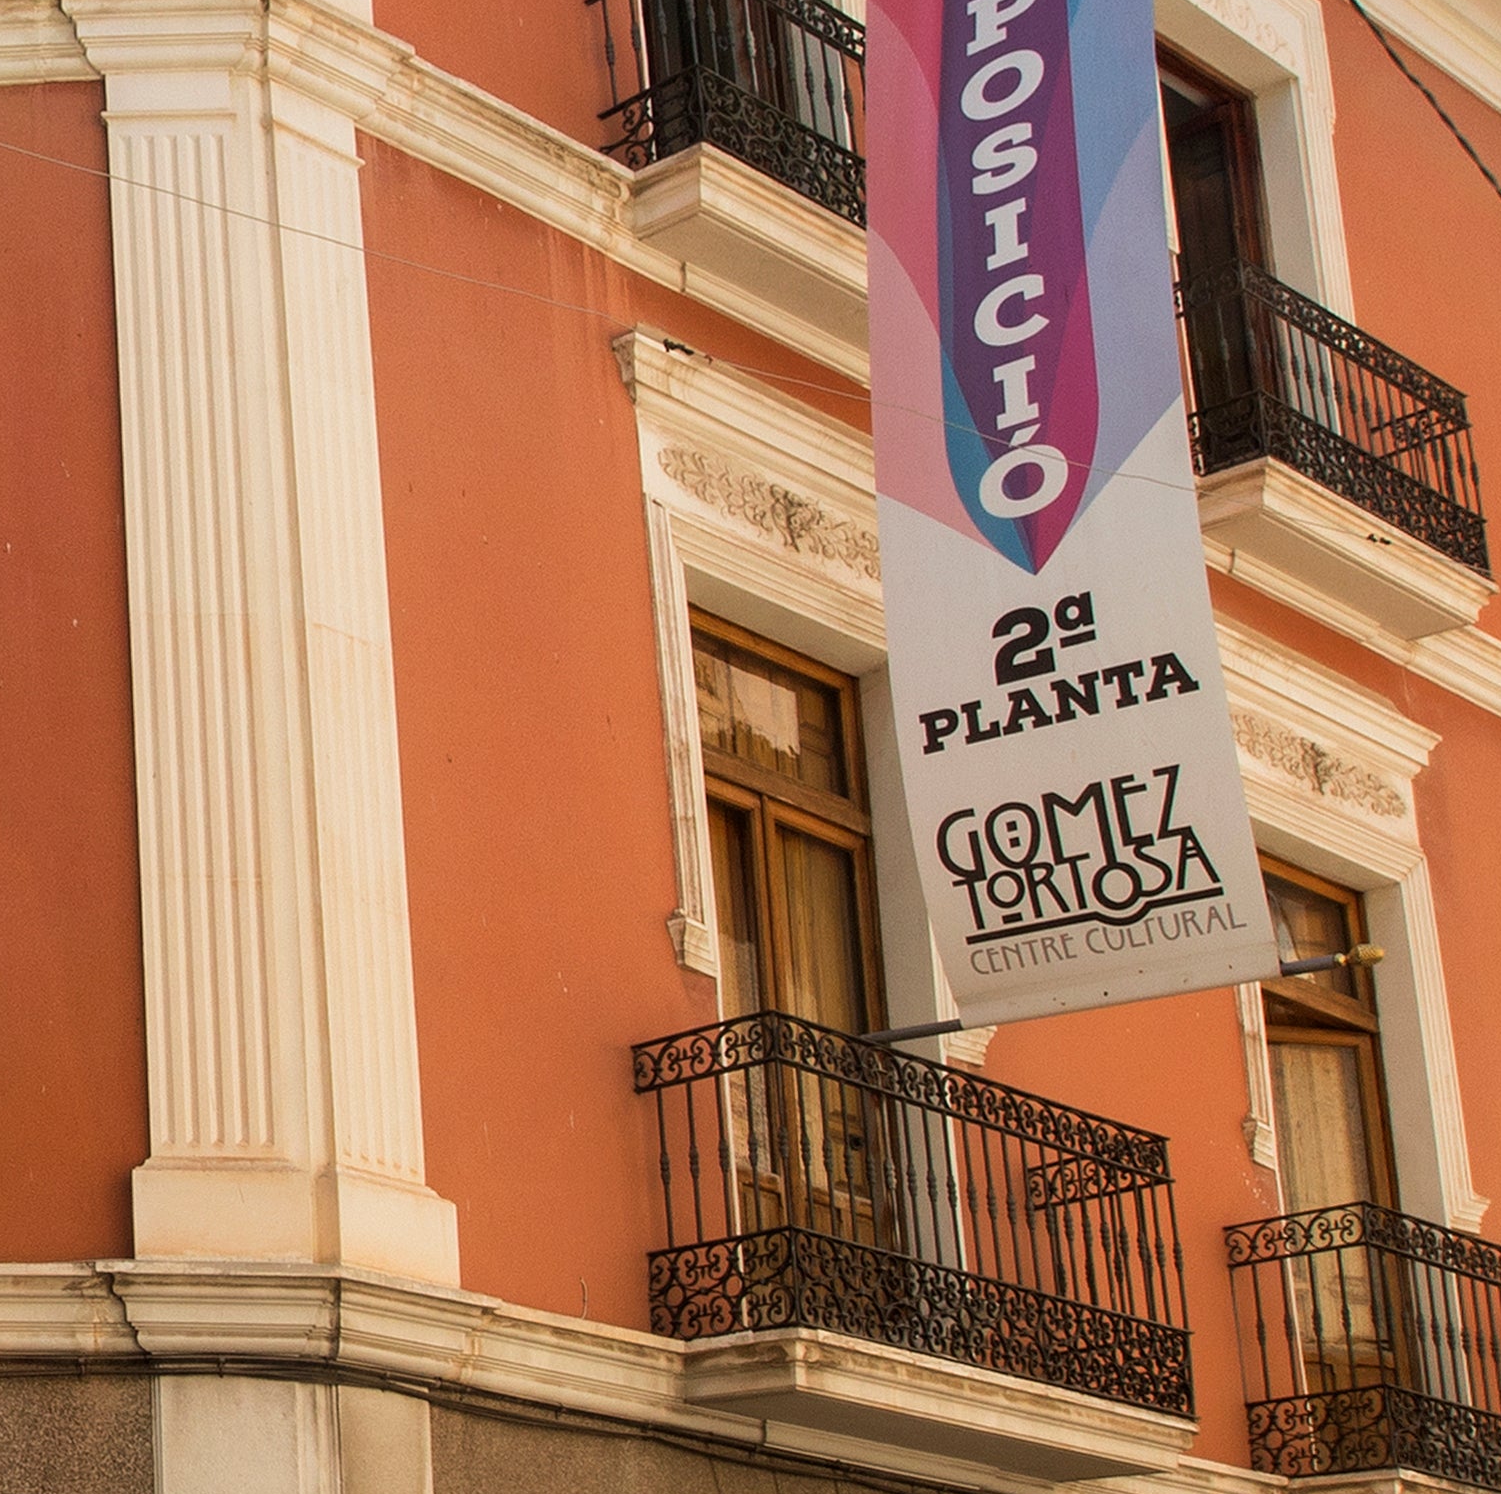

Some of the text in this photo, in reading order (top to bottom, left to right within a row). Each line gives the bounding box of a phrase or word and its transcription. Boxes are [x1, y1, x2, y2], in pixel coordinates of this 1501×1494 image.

[918, 651, 1200, 755] PLANTA
[951, 826, 1221, 931] TORTOSA
[969, 903, 1248, 976] CENTRE CULTURAL
